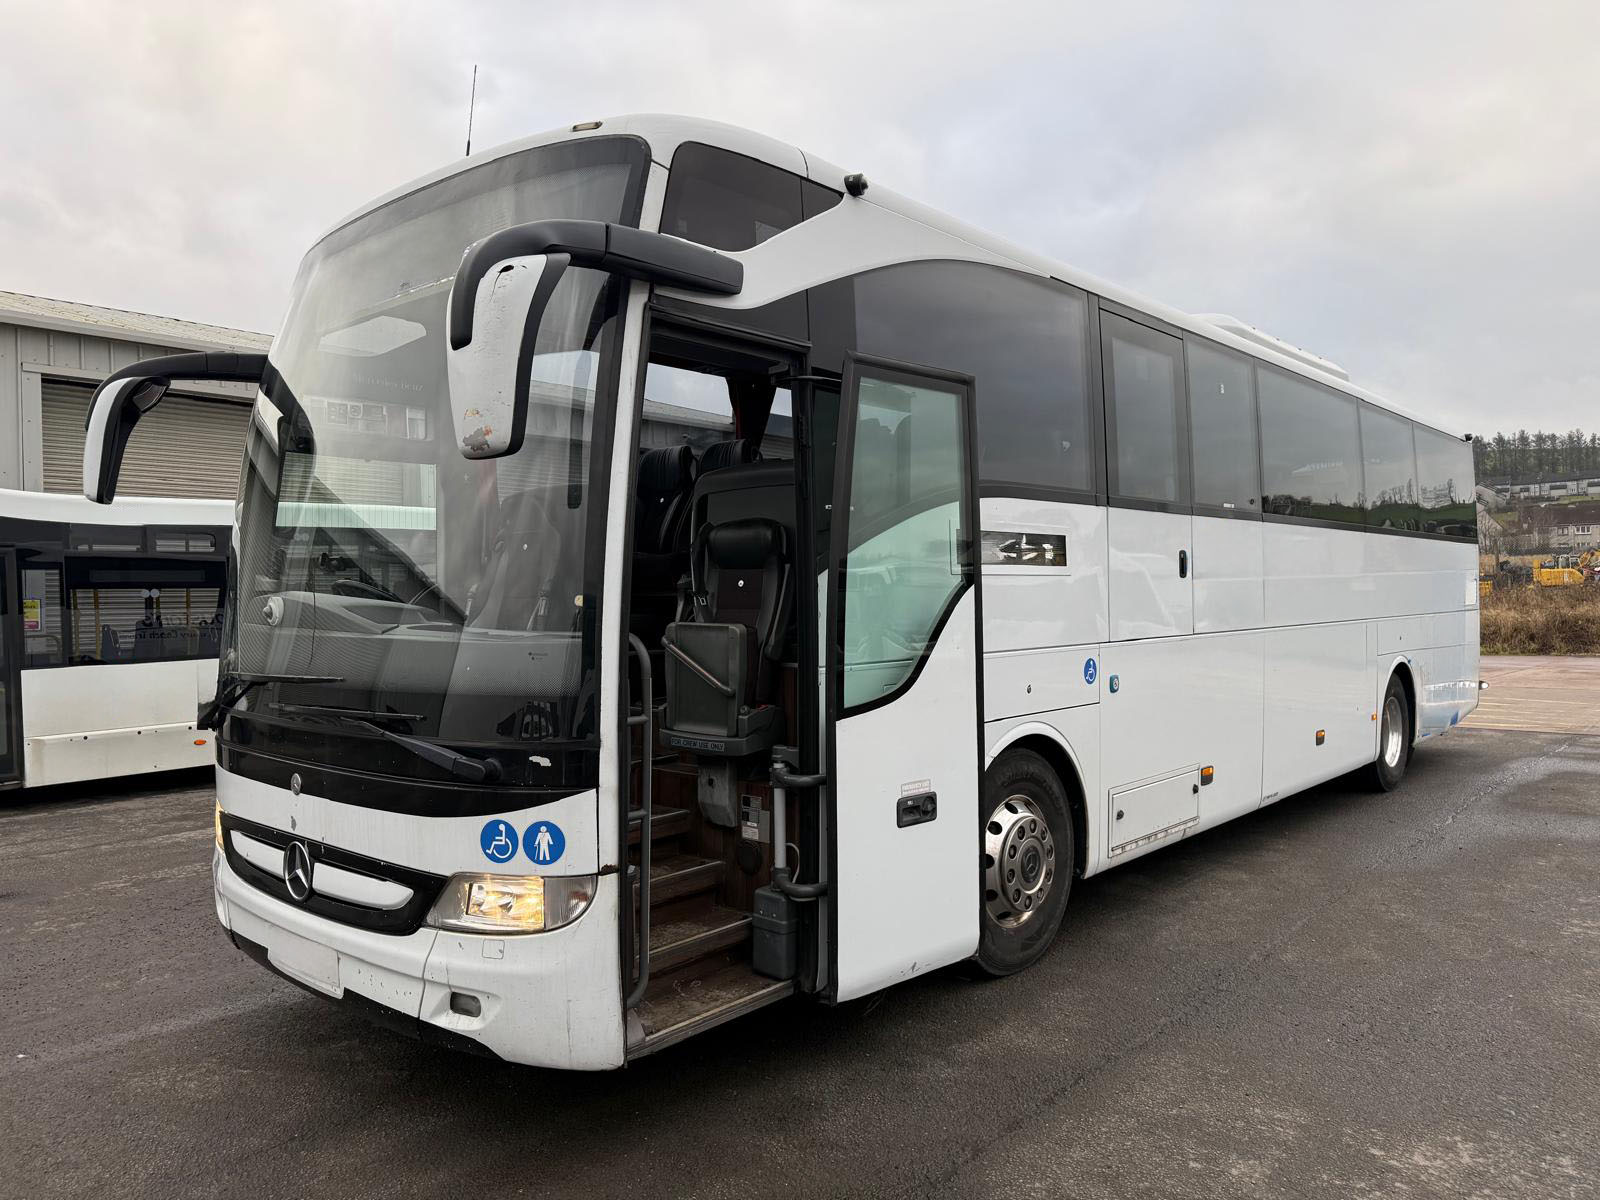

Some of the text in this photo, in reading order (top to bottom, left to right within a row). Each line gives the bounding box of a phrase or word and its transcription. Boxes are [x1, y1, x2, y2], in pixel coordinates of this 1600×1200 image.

[682, 739, 697, 747] CREW
[698, 741, 709, 749] USE
[710, 742, 724, 751] ONLY
